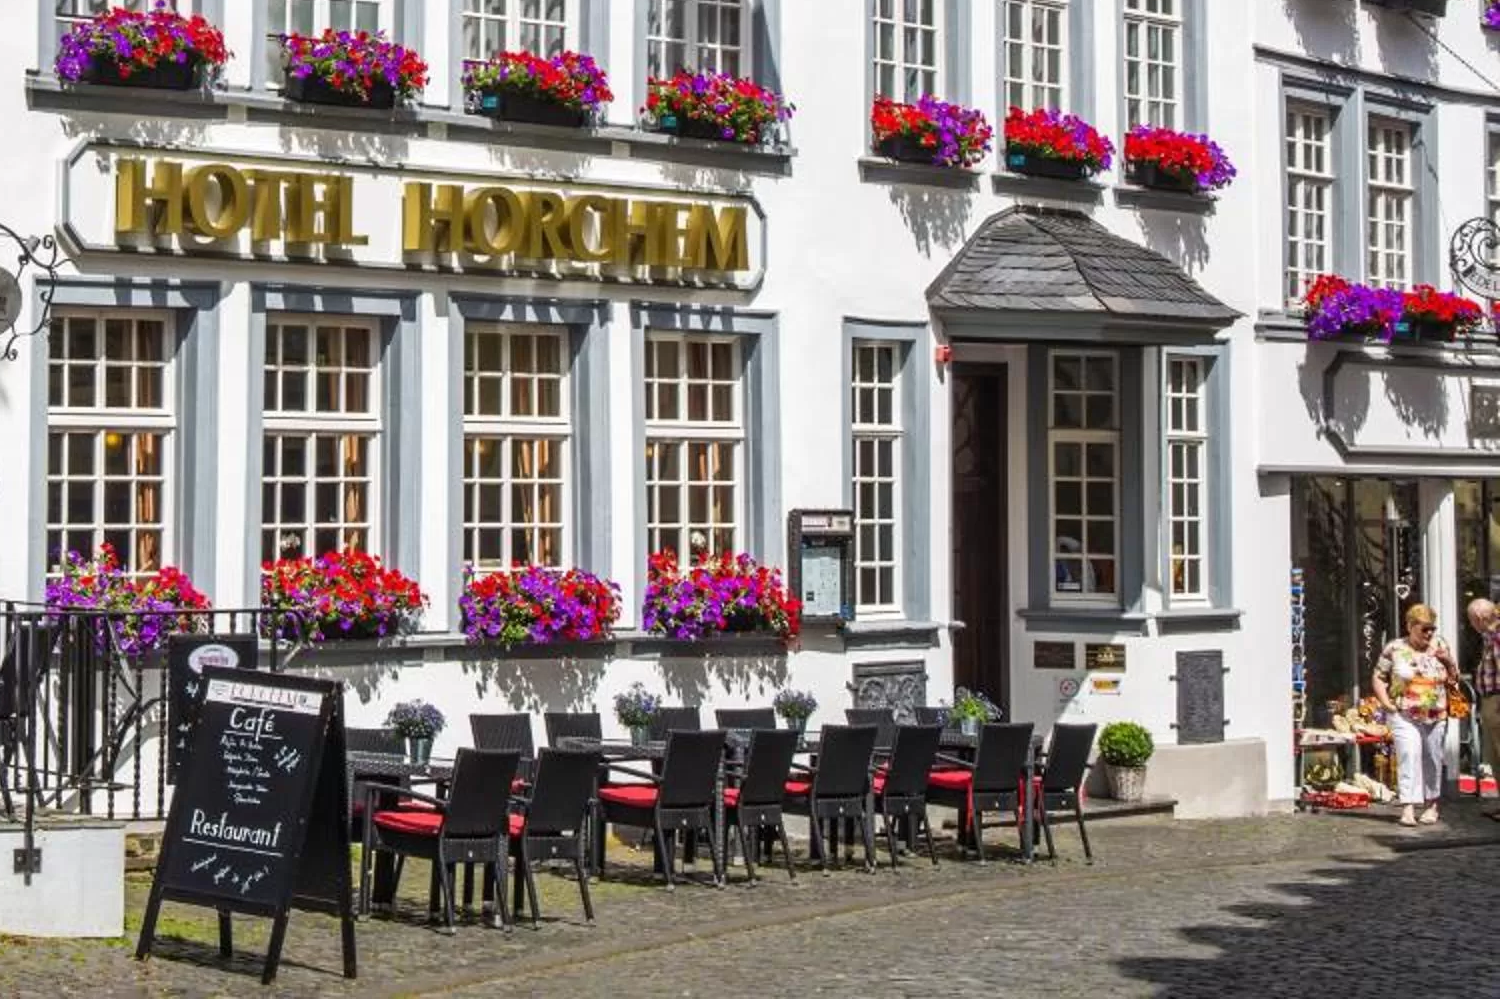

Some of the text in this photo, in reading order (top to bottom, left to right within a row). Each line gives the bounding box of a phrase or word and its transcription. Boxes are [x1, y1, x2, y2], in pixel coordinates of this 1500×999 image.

[116, 159, 749, 270] HOTEL HORCHEM
[229, 706, 276, 744] Café
[190, 808, 283, 848] Restaurant
